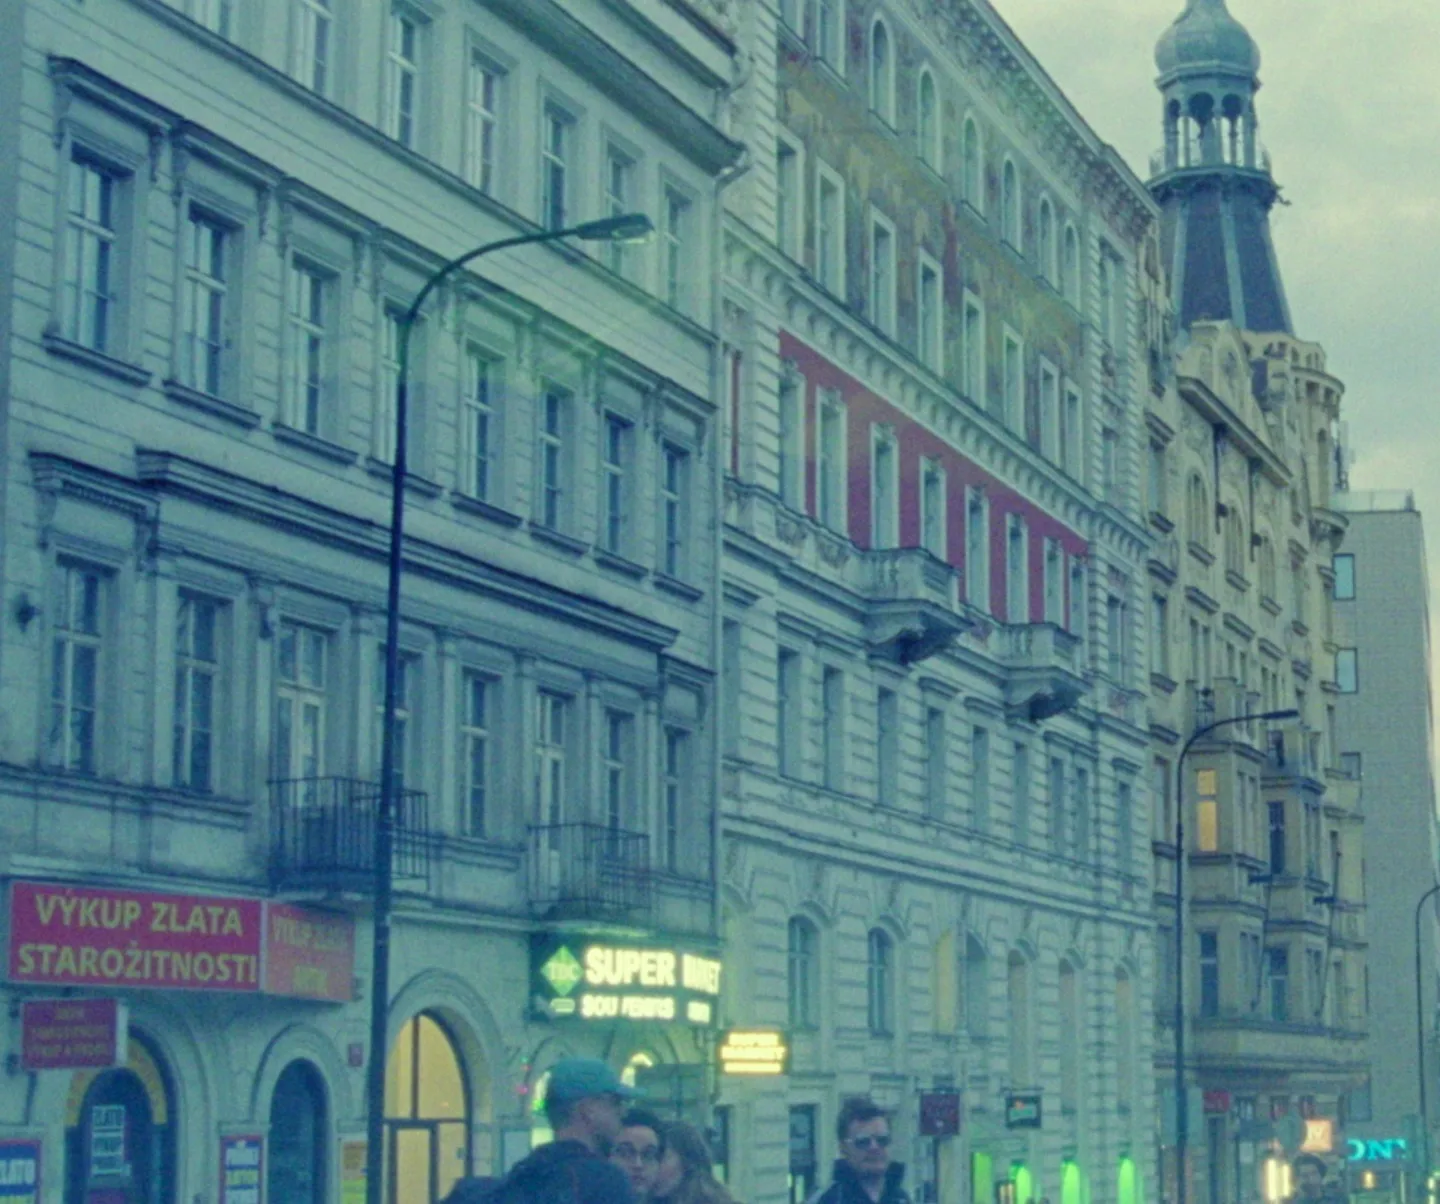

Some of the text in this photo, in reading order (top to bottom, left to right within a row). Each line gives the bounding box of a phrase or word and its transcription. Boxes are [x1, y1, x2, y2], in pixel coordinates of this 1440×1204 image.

[36, 888, 243, 937] VÝKUP ZLATA
[18, 940, 257, 983] STAROŽITNOSTI
[585, 943, 677, 987] SUPER
